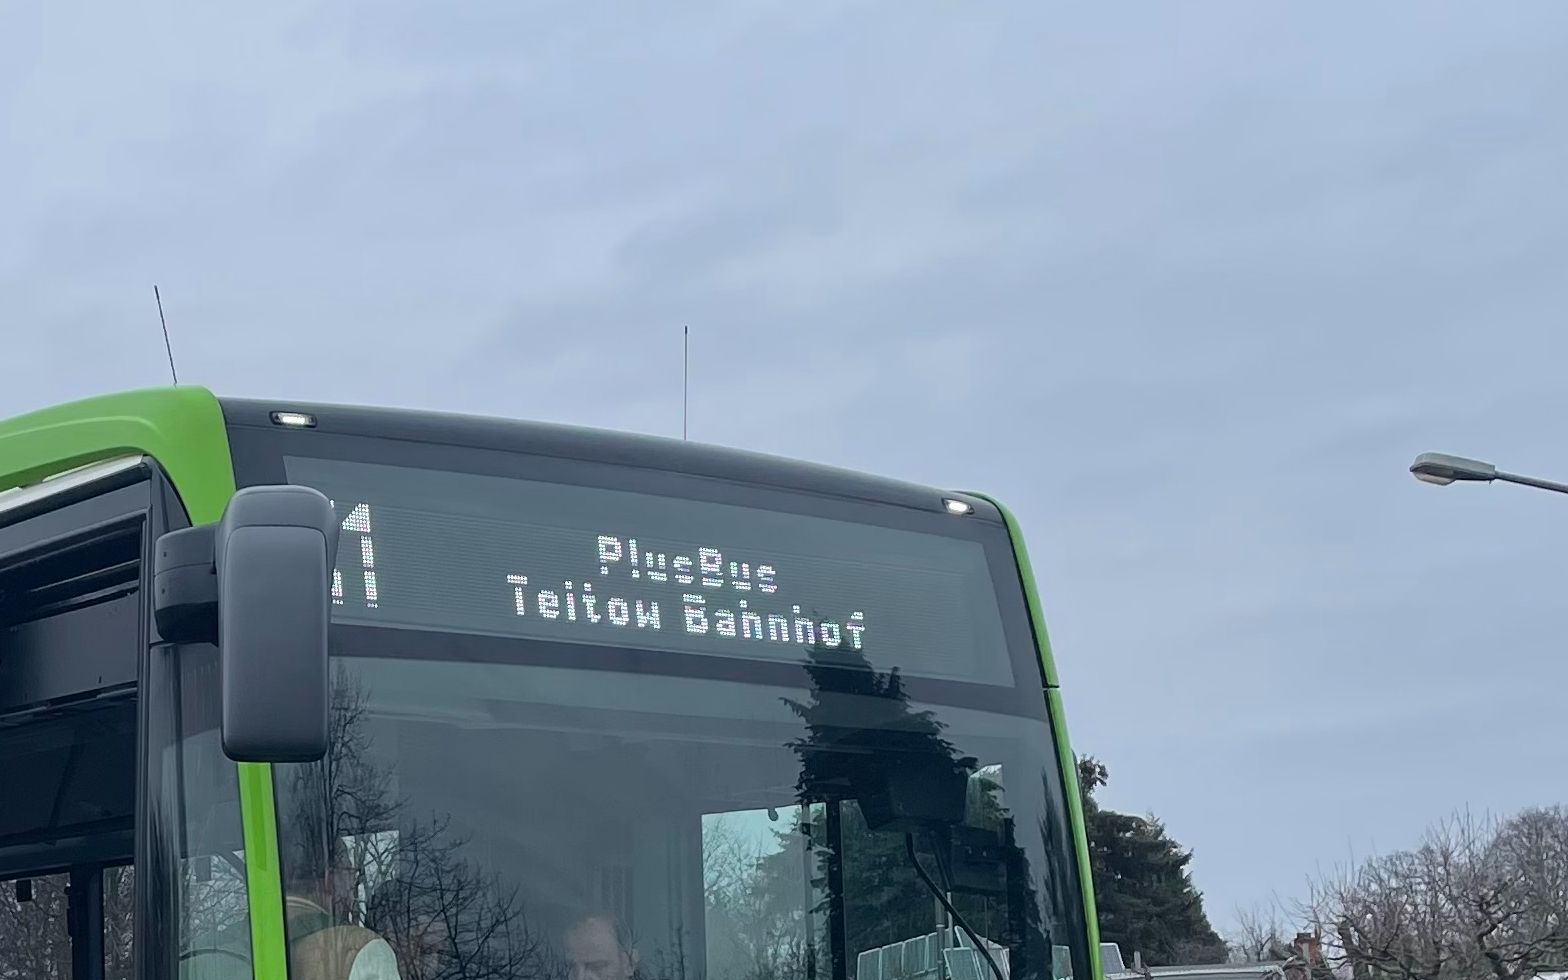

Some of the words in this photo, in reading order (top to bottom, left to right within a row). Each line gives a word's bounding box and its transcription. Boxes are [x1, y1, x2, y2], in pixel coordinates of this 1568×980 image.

[330, 500, 378, 608] 1
[597, 535, 778, 593] PlusBus
[682, 593, 865, 649] Bahnhof
